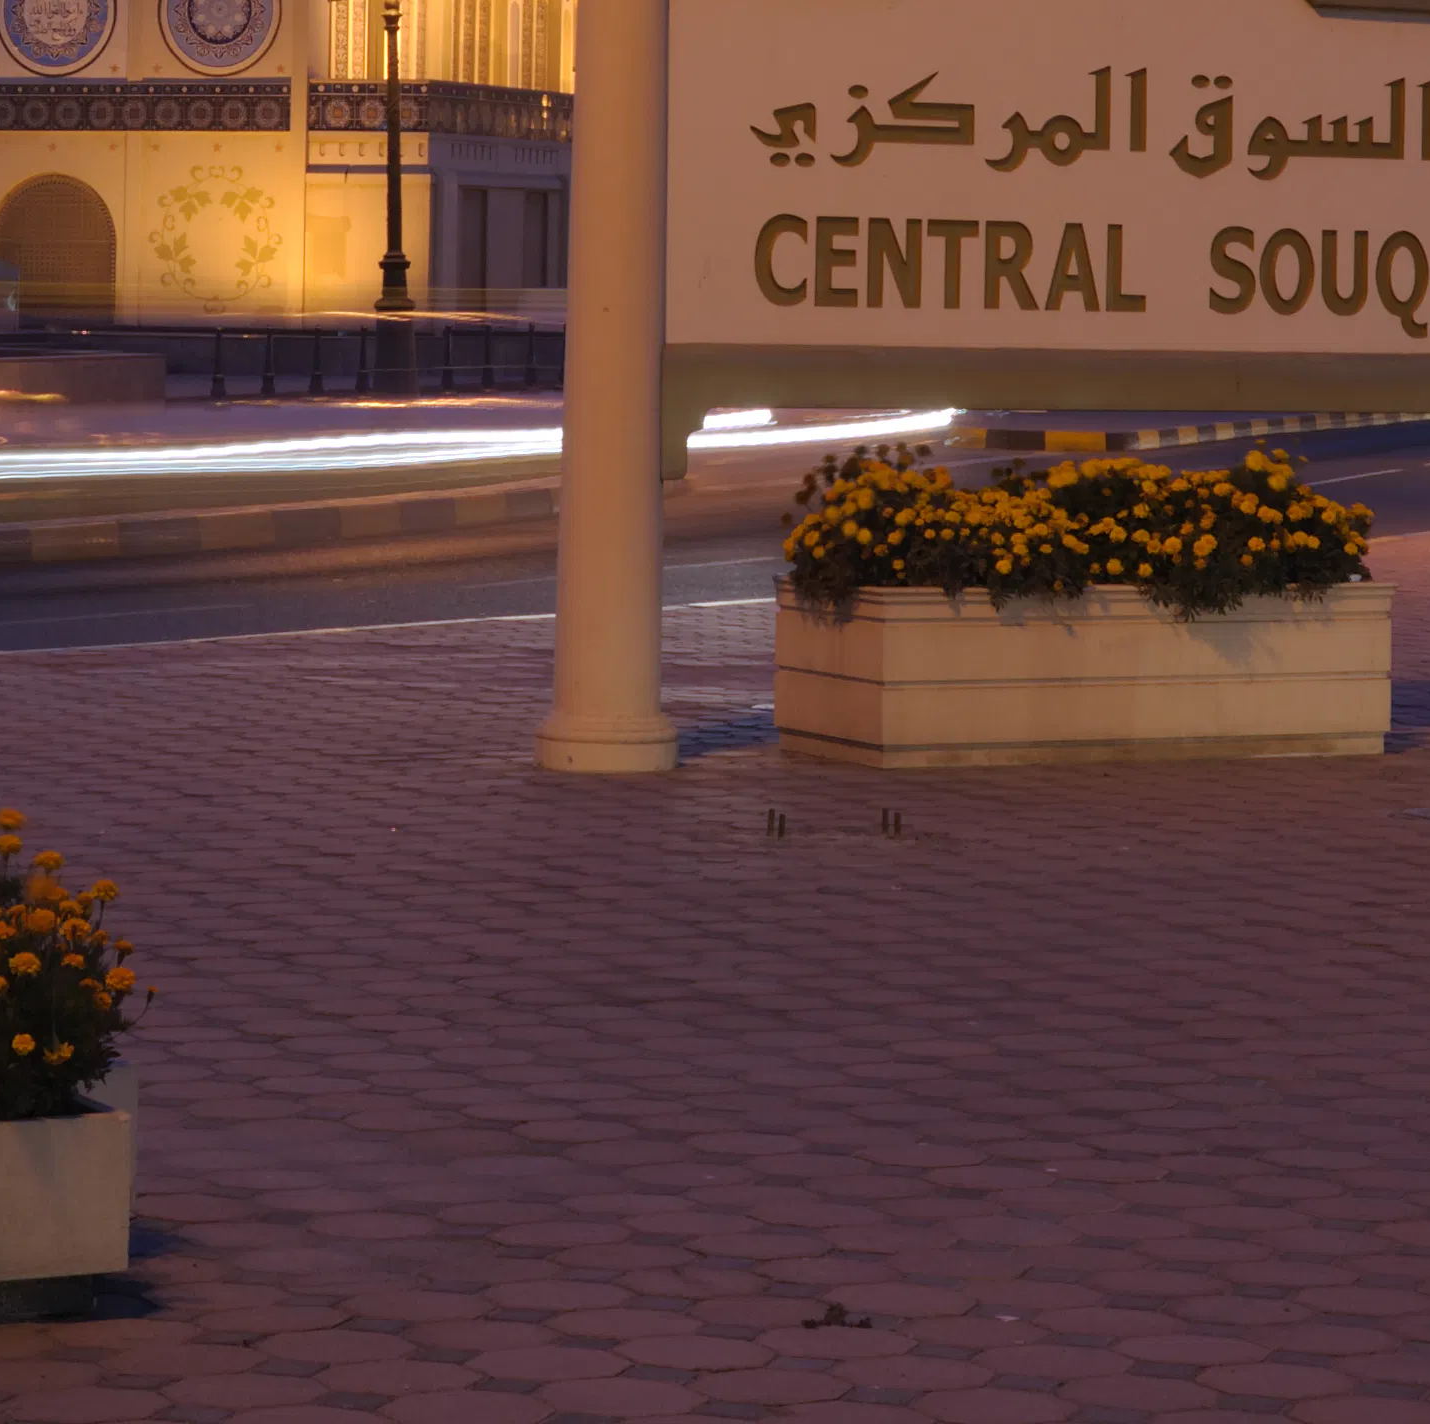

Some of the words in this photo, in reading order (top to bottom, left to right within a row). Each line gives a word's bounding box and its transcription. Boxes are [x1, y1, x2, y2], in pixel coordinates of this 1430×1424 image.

[749, 65, 1148, 174] المركزي
[753, 213, 1147, 313] CENTRAL
[1208, 225, 1430, 337] SOUQ
